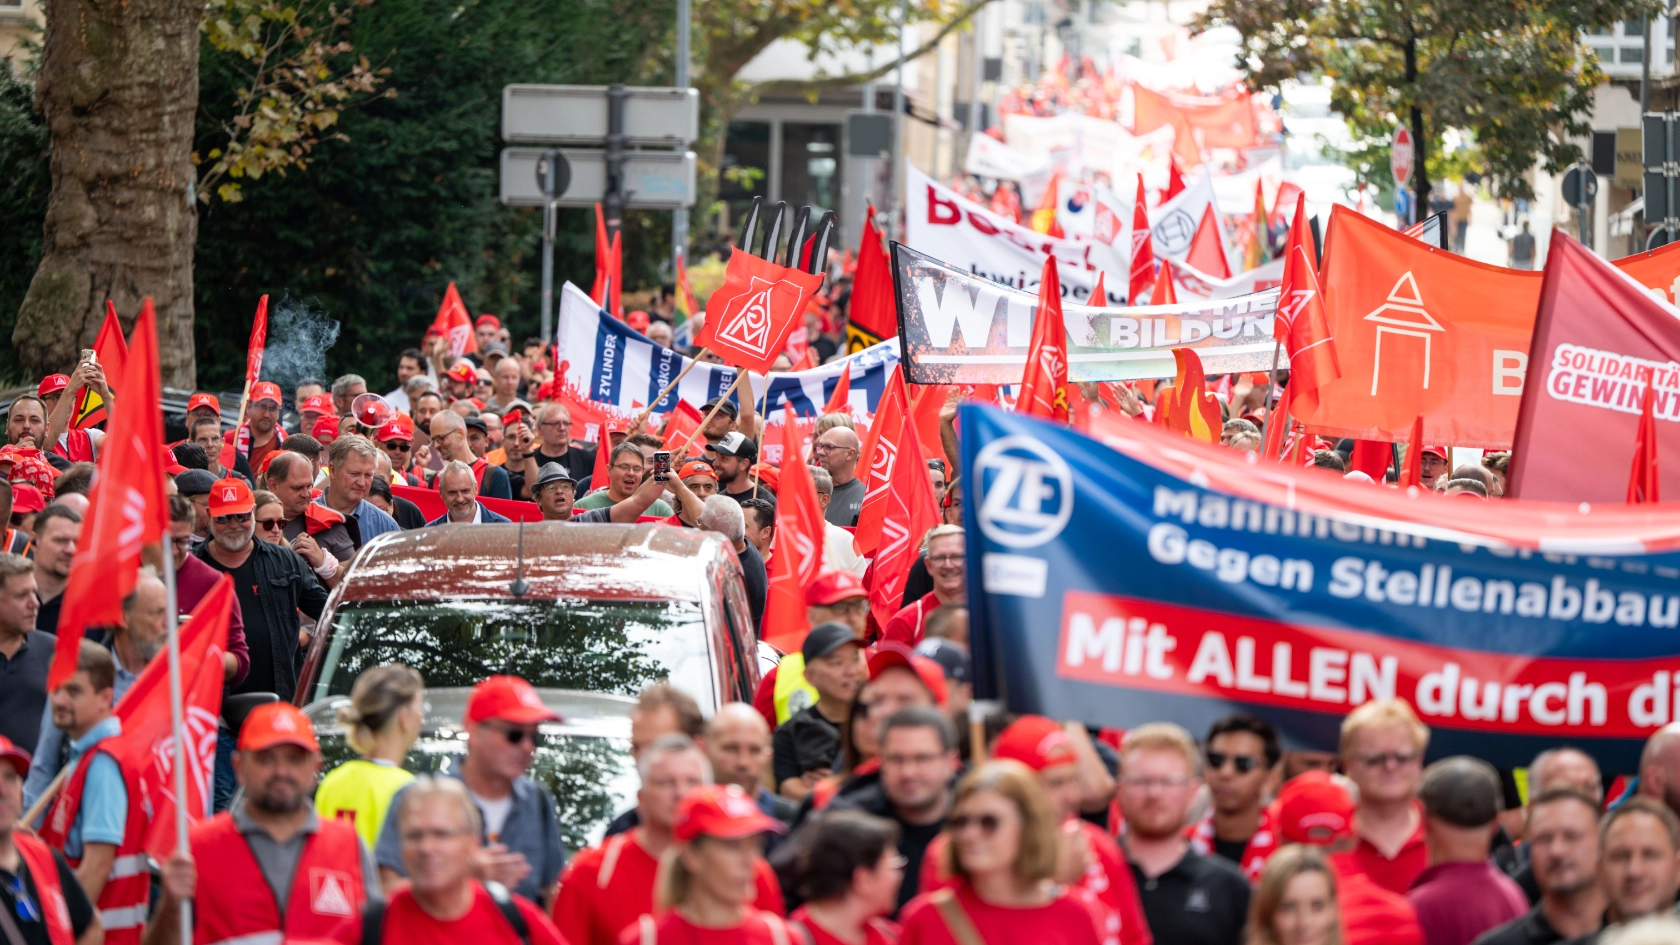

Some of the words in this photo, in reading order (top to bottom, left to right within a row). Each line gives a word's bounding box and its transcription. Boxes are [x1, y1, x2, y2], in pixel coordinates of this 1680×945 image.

[599, 334, 617, 396] ZYLINDER
[979, 450, 1066, 532] ZF
[1147, 522, 1314, 593] Gegen
[1328, 556, 1680, 629] Stellenabbau
[1065, 612, 1178, 680] Mit
[1186, 630, 1399, 706] ALLEN
[1415, 662, 1608, 727] durch
